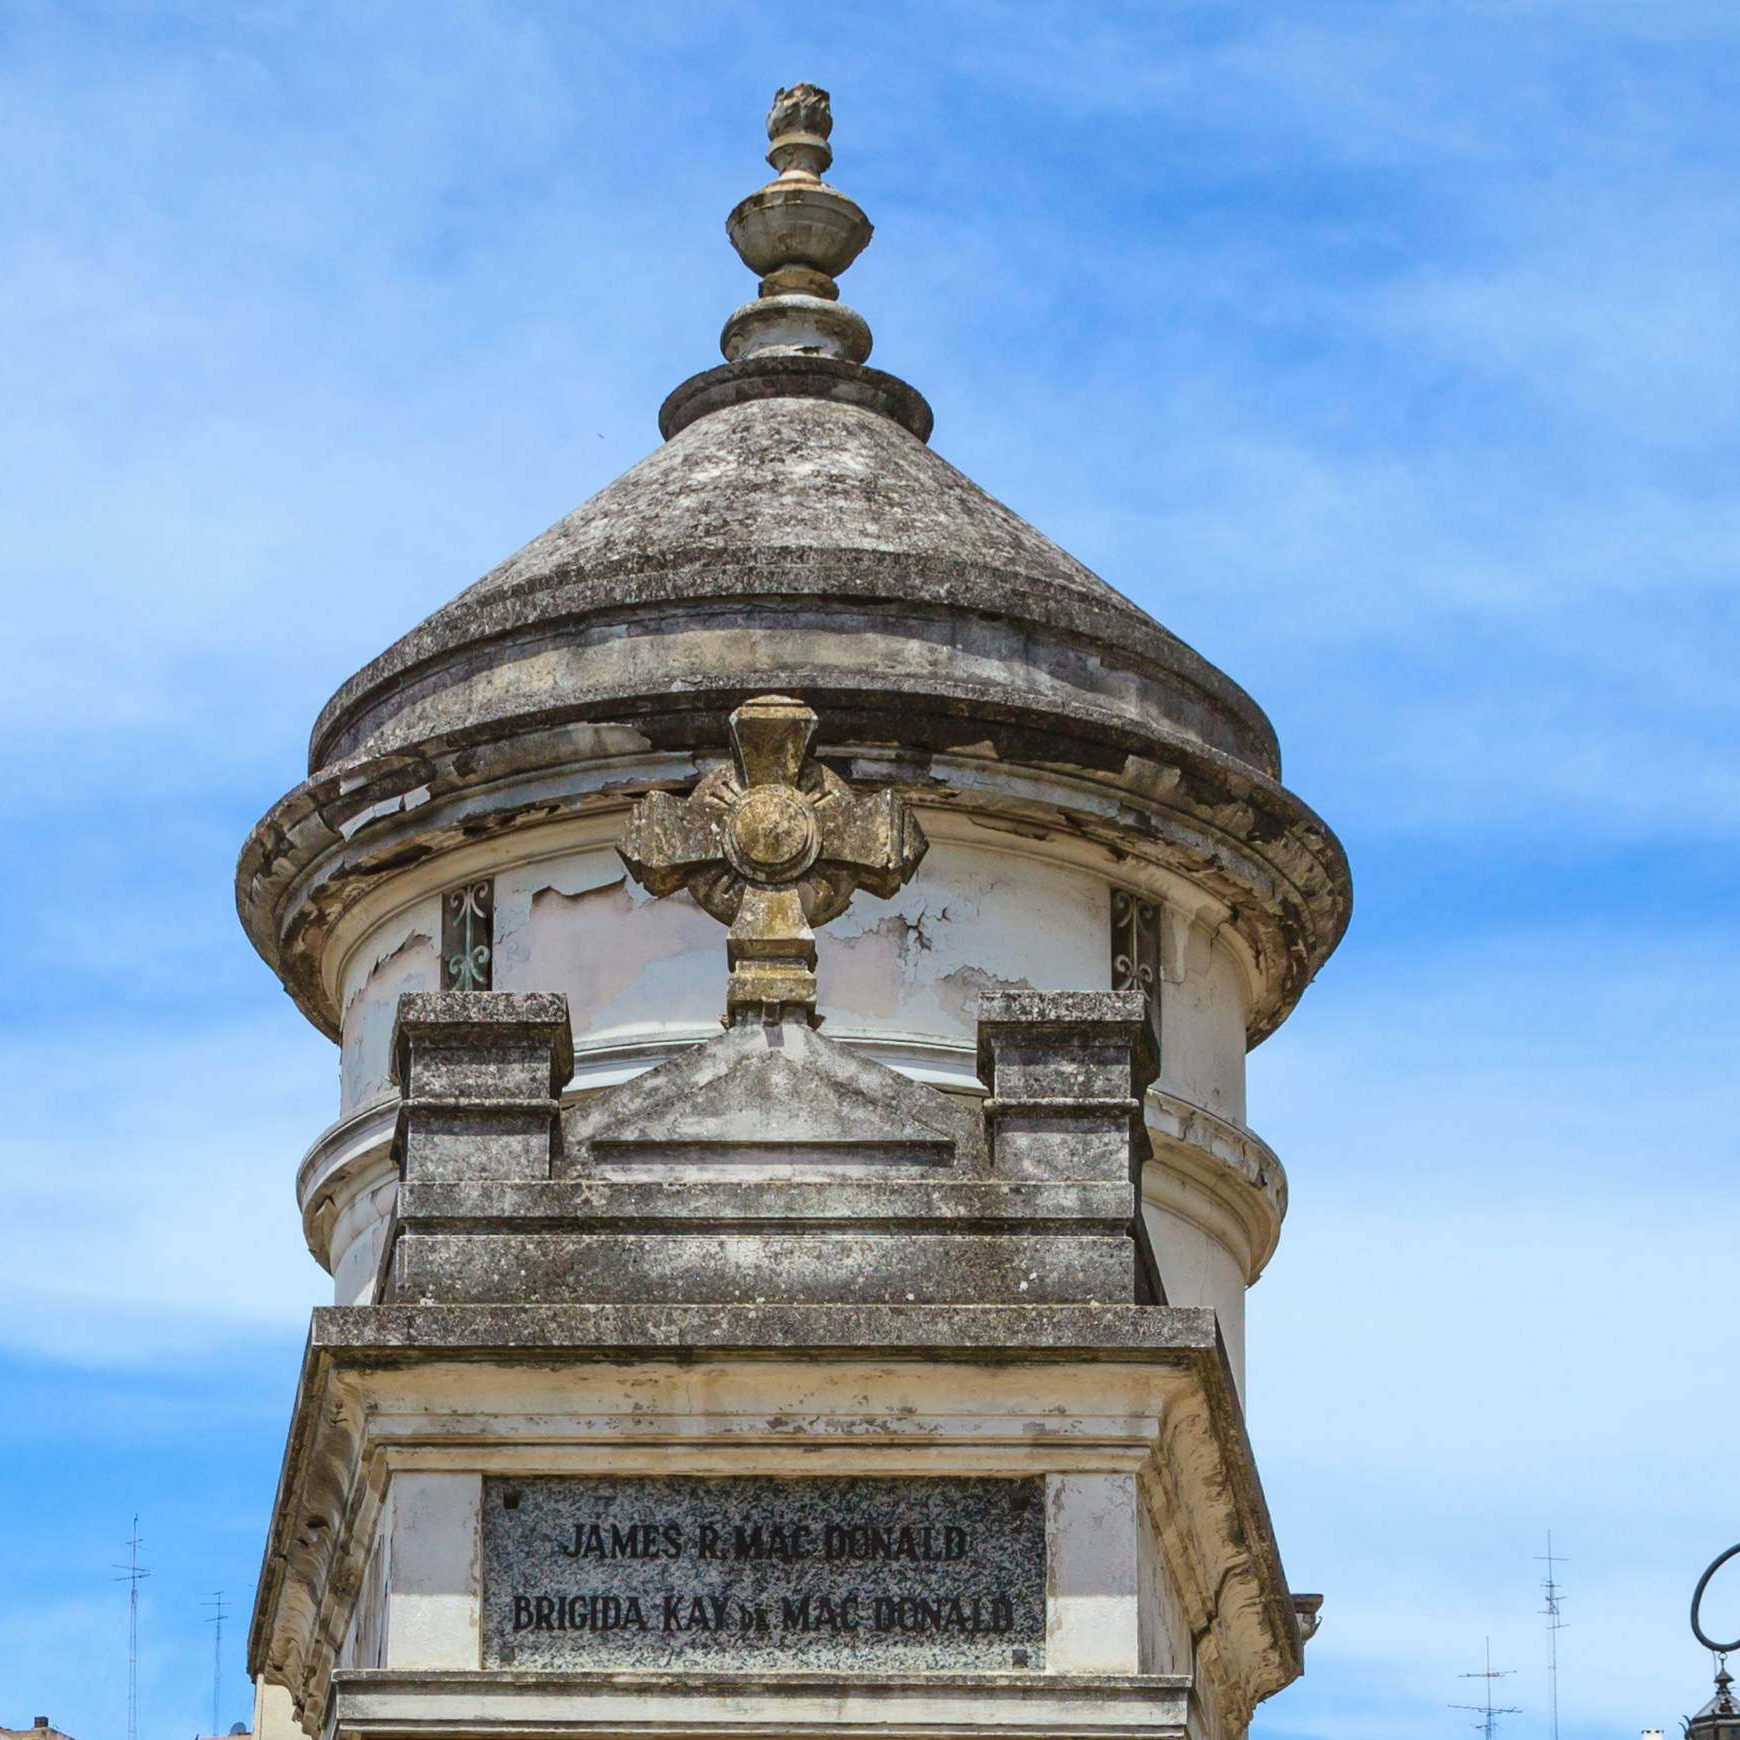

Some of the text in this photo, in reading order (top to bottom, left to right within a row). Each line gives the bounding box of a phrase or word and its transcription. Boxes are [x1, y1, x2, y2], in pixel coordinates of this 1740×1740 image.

[563, 1523, 684, 1560] JAMES
[735, 1525, 812, 1560] MAC
[824, 1525, 967, 1561] DONALD
[512, 1596, 647, 1632] BRIGIDA
[662, 1596, 730, 1632] KAY
[781, 1597, 860, 1632] MAC
[874, 1597, 1014, 1632] DONALD
